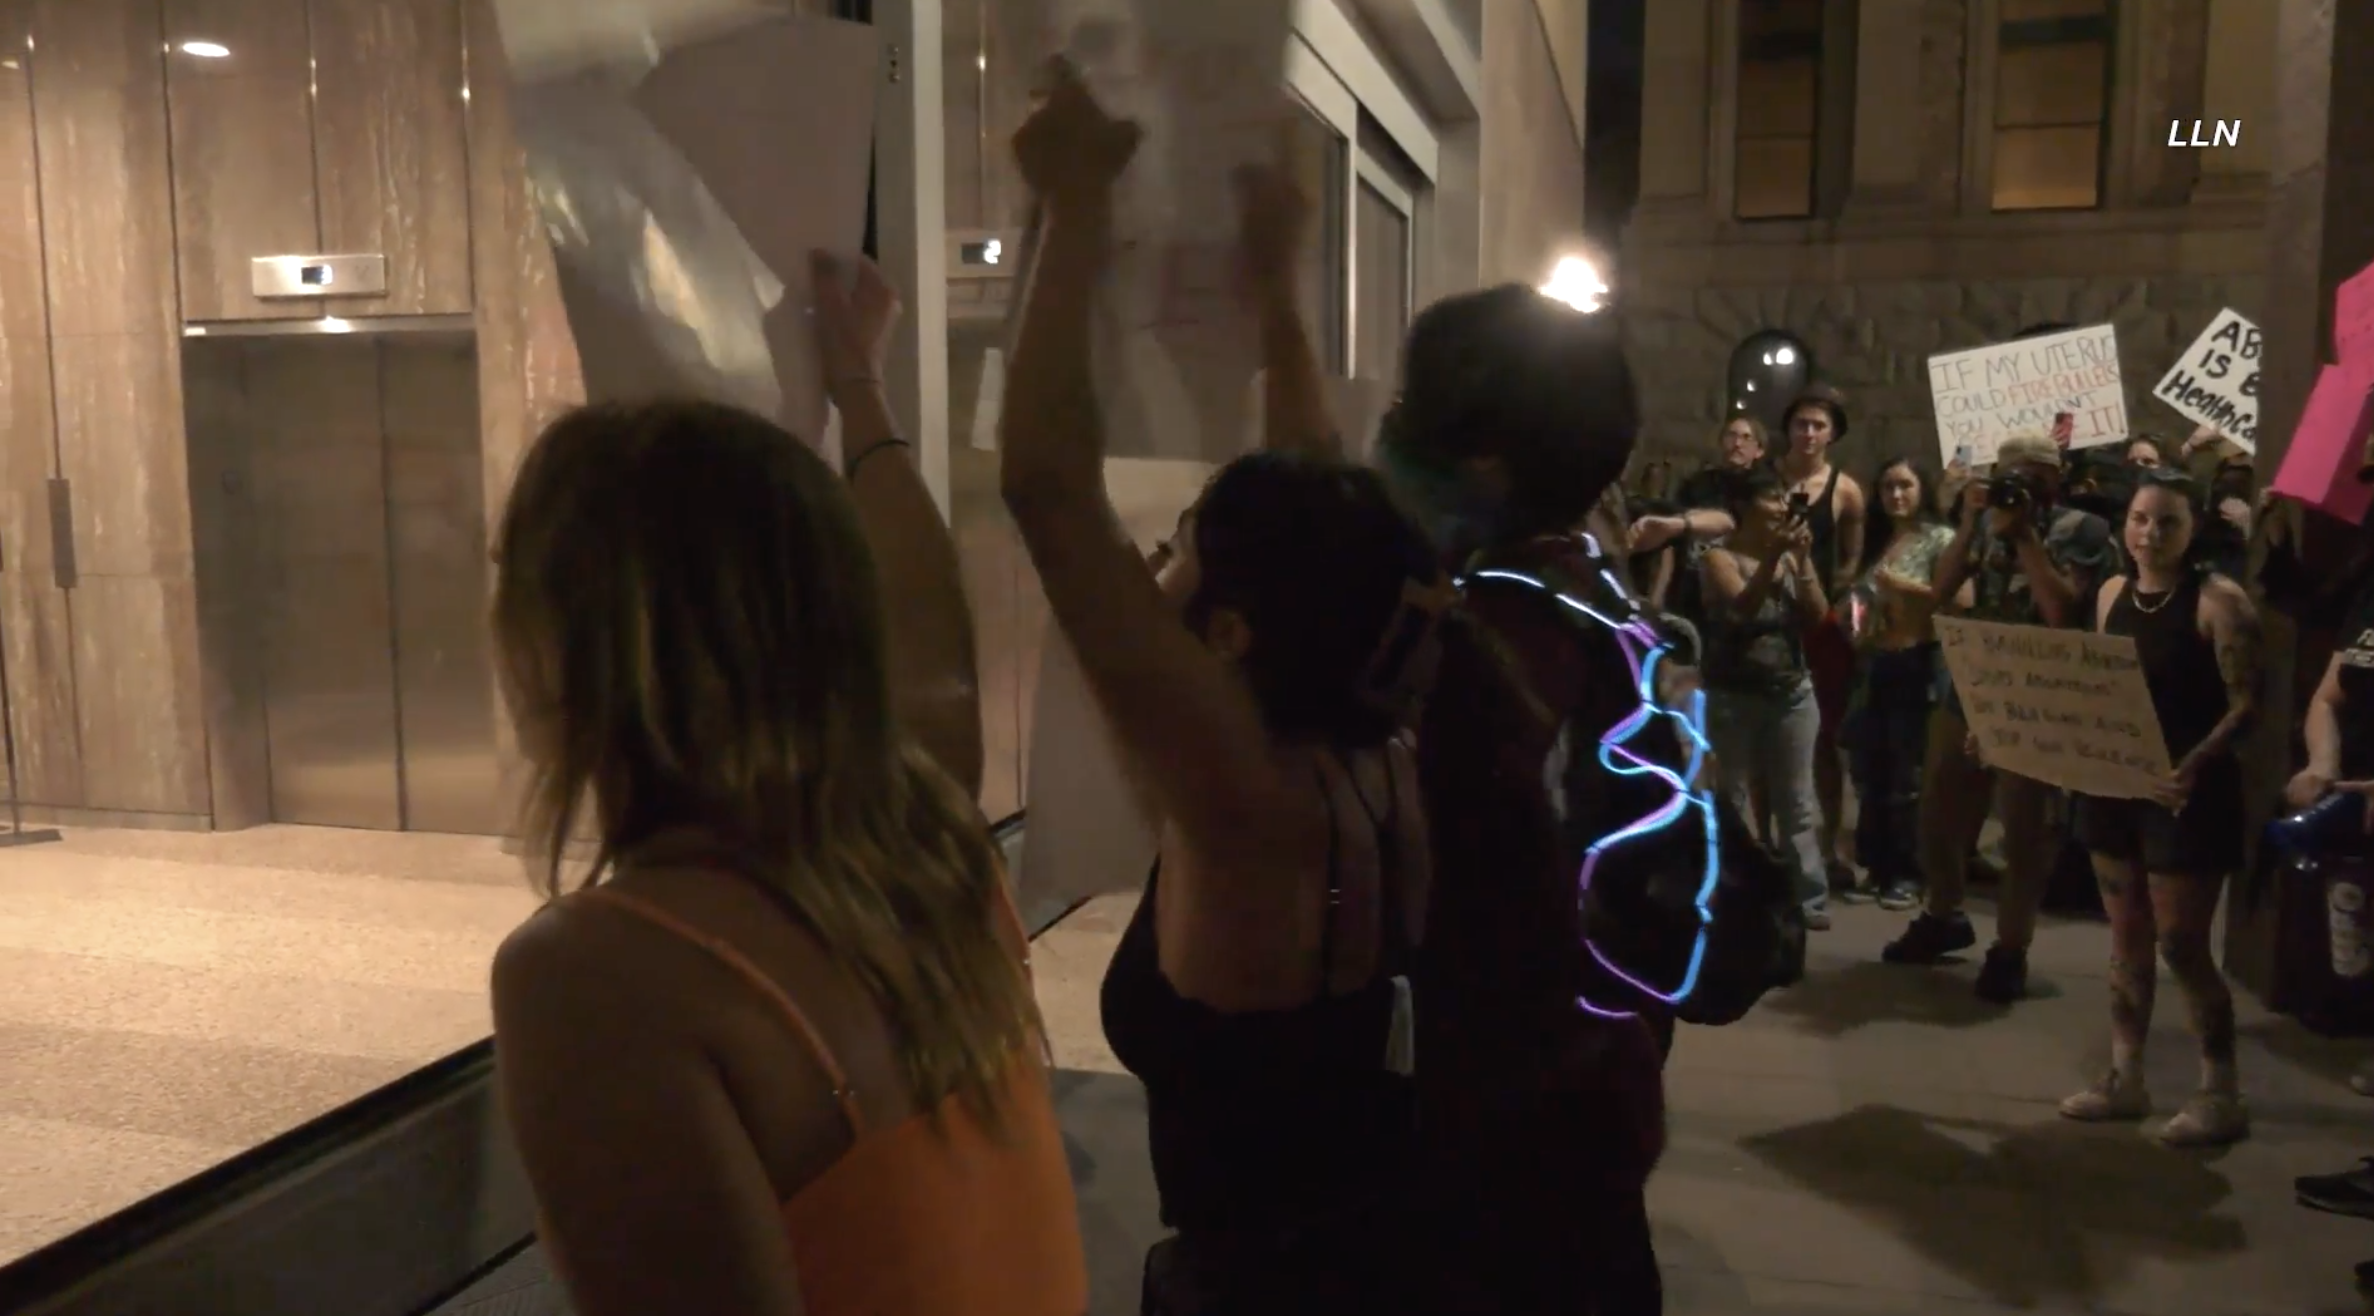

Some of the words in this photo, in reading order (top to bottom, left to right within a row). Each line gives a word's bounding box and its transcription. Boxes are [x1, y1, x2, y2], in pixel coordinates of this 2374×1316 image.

[1931, 358, 1973, 394] IF
[1986, 352, 2020, 387] MY
[2198, 348, 2232, 379] IS
[1936, 389, 2007, 417] COULD
[2008, 379, 2052, 406] FIRE
[1945, 416, 1984, 439] YOU
